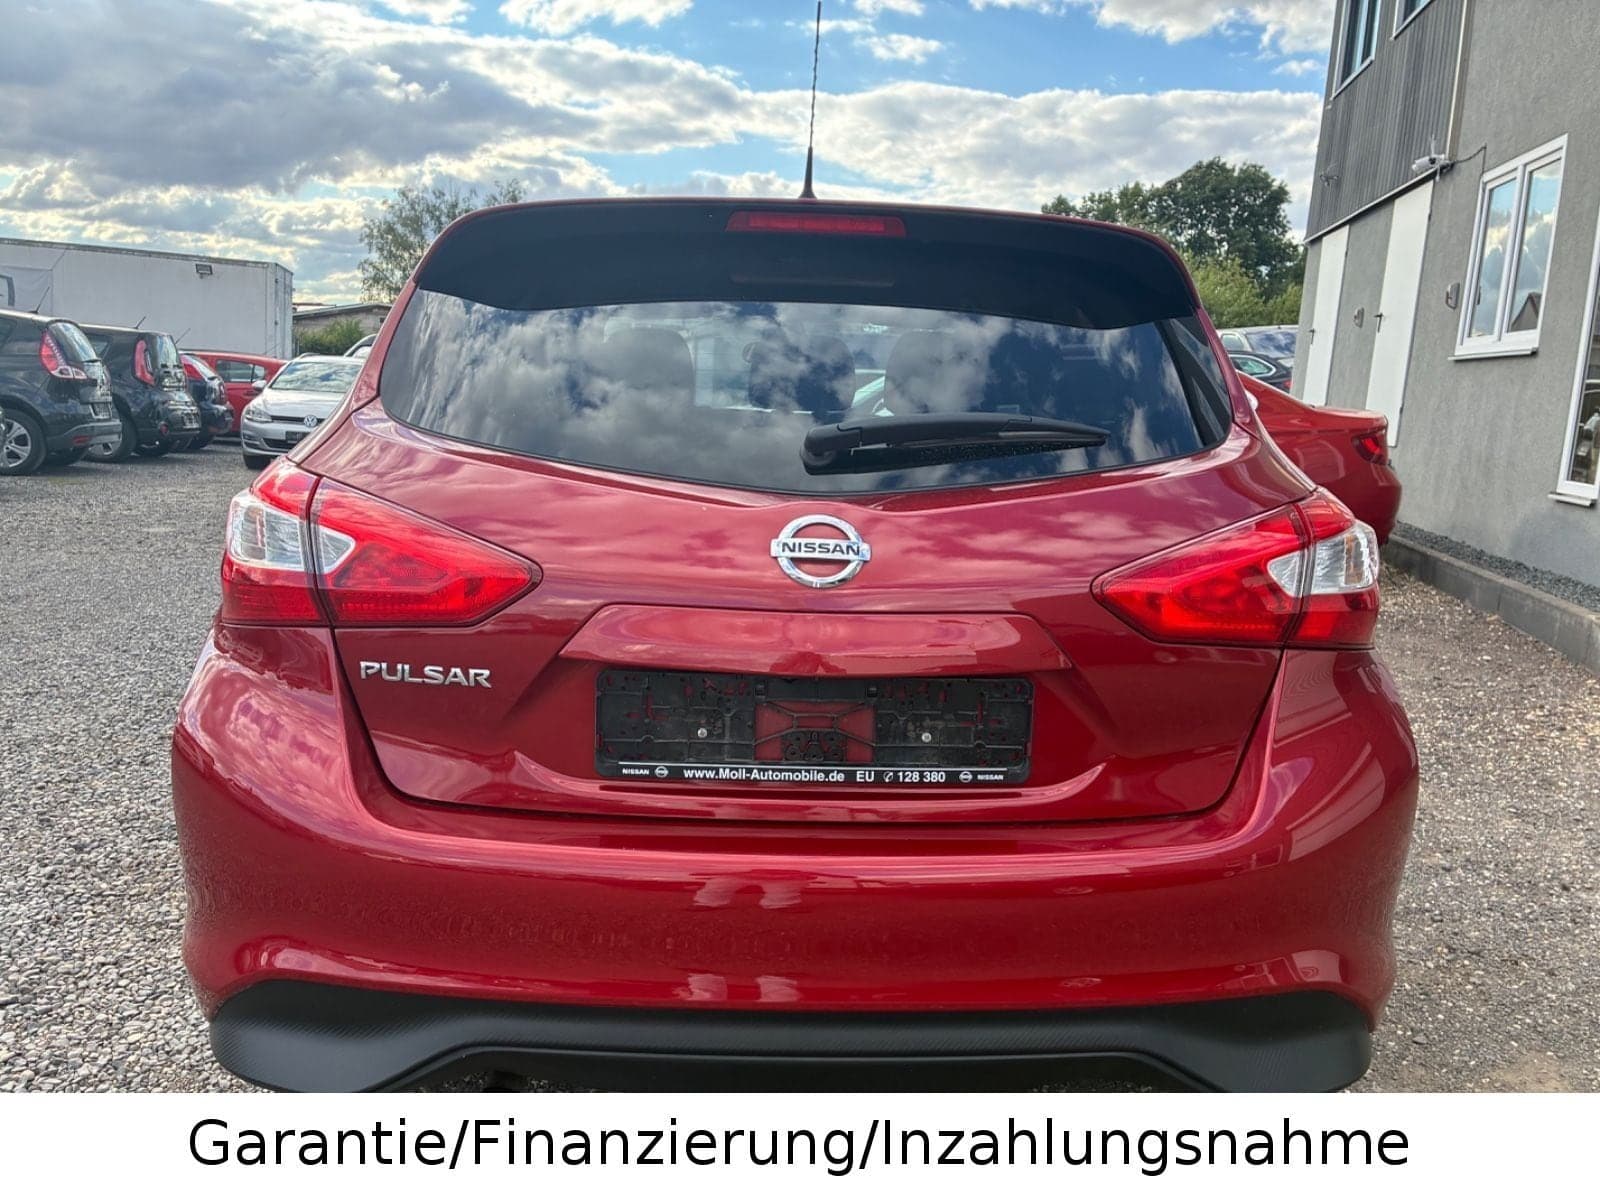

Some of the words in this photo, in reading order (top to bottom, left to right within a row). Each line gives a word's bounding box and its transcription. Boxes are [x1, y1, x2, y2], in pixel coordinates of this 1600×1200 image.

[781, 542, 860, 556] NISSAN
[359, 661, 492, 688] PULSAR
[622, 767, 650, 776] NISSAN
[683, 768, 845, 783] www.Moll-Automobile.de
[856, 771, 875, 783] EU
[897, 771, 920, 783] 128
[922, 771, 946, 783] 380
